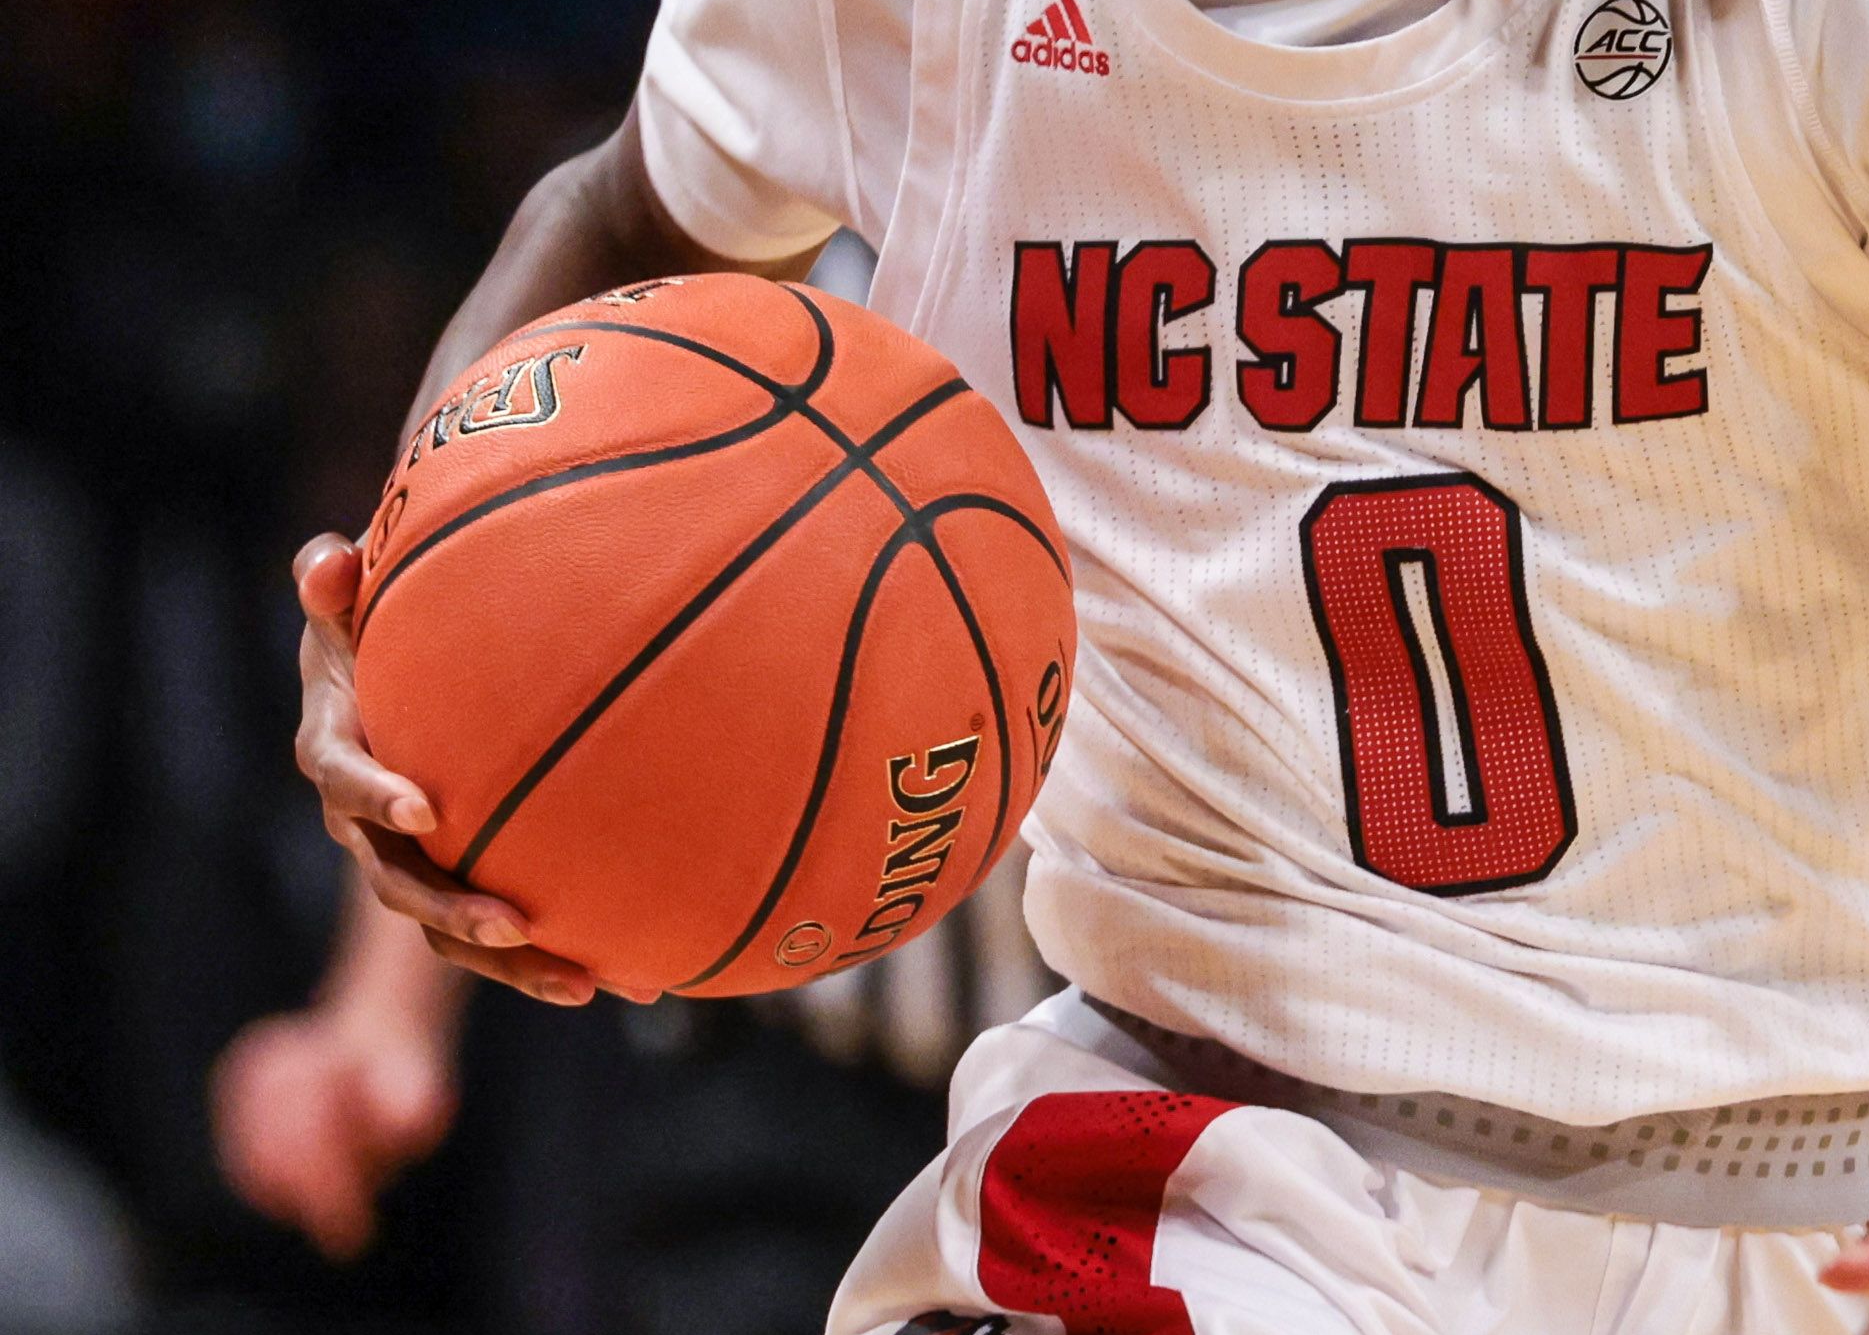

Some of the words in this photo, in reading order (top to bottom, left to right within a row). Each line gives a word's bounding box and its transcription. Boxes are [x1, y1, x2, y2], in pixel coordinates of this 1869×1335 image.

[1011, 38, 1109, 76] adidas
[1584, 28, 1671, 53] ACC
[1010, 240, 1216, 431] NC
[1236, 237, 1713, 432] STATE
[1299, 471, 1578, 898] 0
